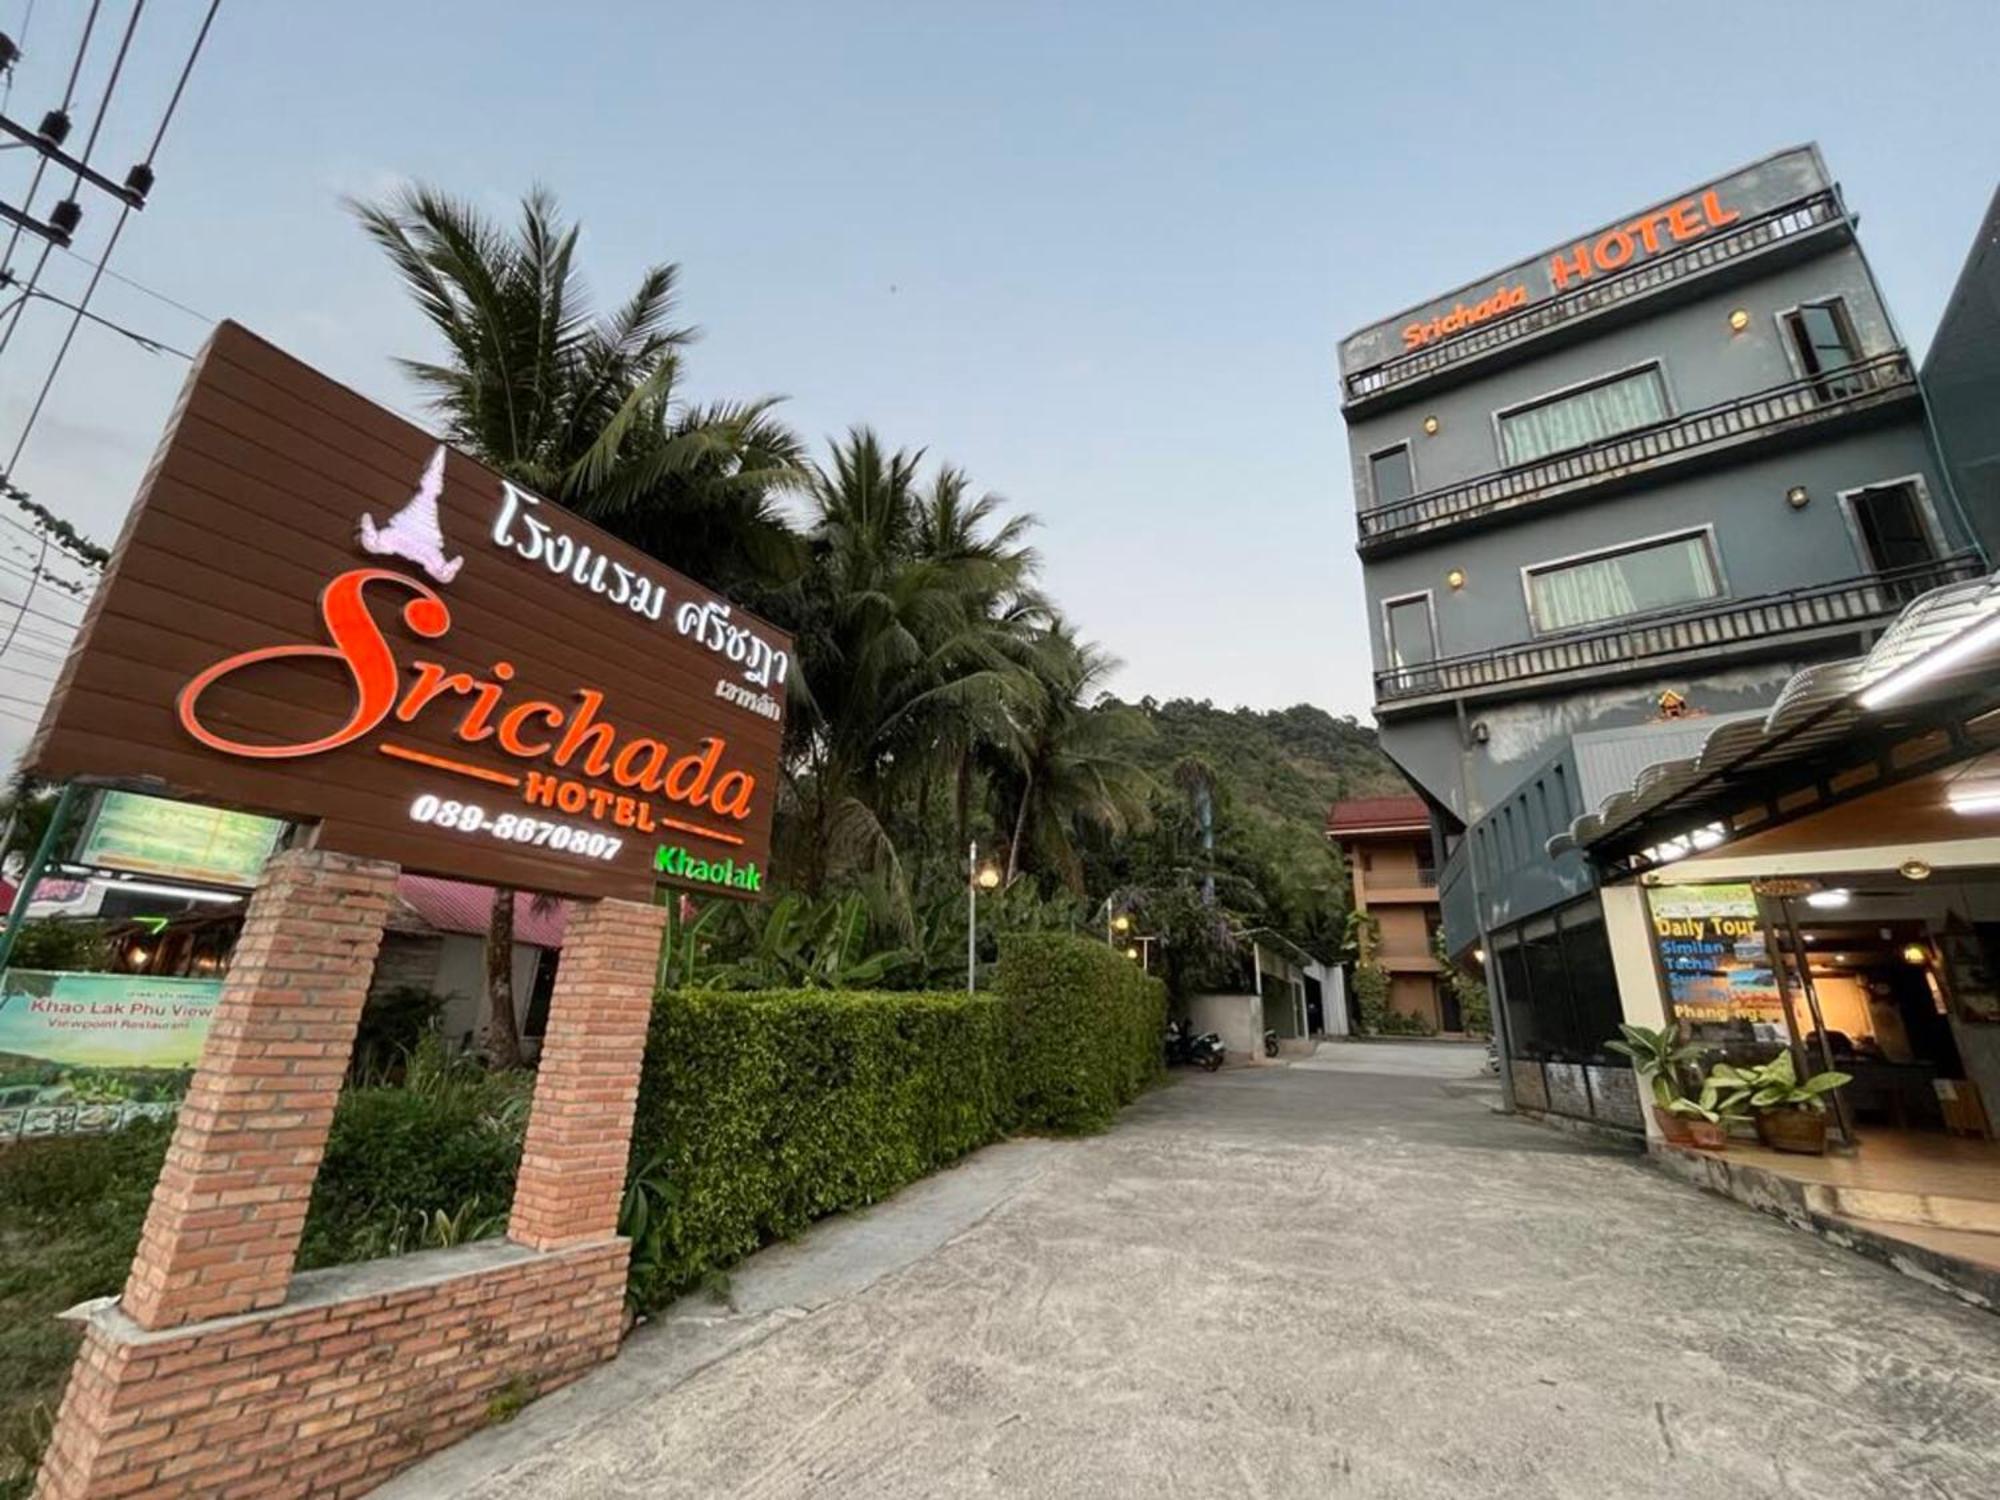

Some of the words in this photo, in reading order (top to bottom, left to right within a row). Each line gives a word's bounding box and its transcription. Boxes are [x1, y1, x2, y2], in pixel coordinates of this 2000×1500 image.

[1402, 283, 1527, 350] Srichada
[1550, 191, 1740, 290] HOTEL
[491, 480, 667, 620] โรงแรม
[676, 601, 788, 688] ศรีชฎา
[178, 567, 757, 821] Srichada
[409, 793, 623, 861] 089-8670807
[523, 771, 657, 833] HOTEL
[654, 844, 762, 893] Khaolak
[1657, 916, 1704, 940] Daily
[1711, 917, 1758, 936] Tour
[1660, 939, 1725, 955] Similan
[31, 1000, 85, 1015] Khao
[90, 1001, 126, 1015] Lak
[129, 1002, 166, 1017] Phu
[172, 1004, 214, 1017] View
[49, 1017, 119, 1030] Viewpoint
[120, 1019, 191, 1030] Restaurant
